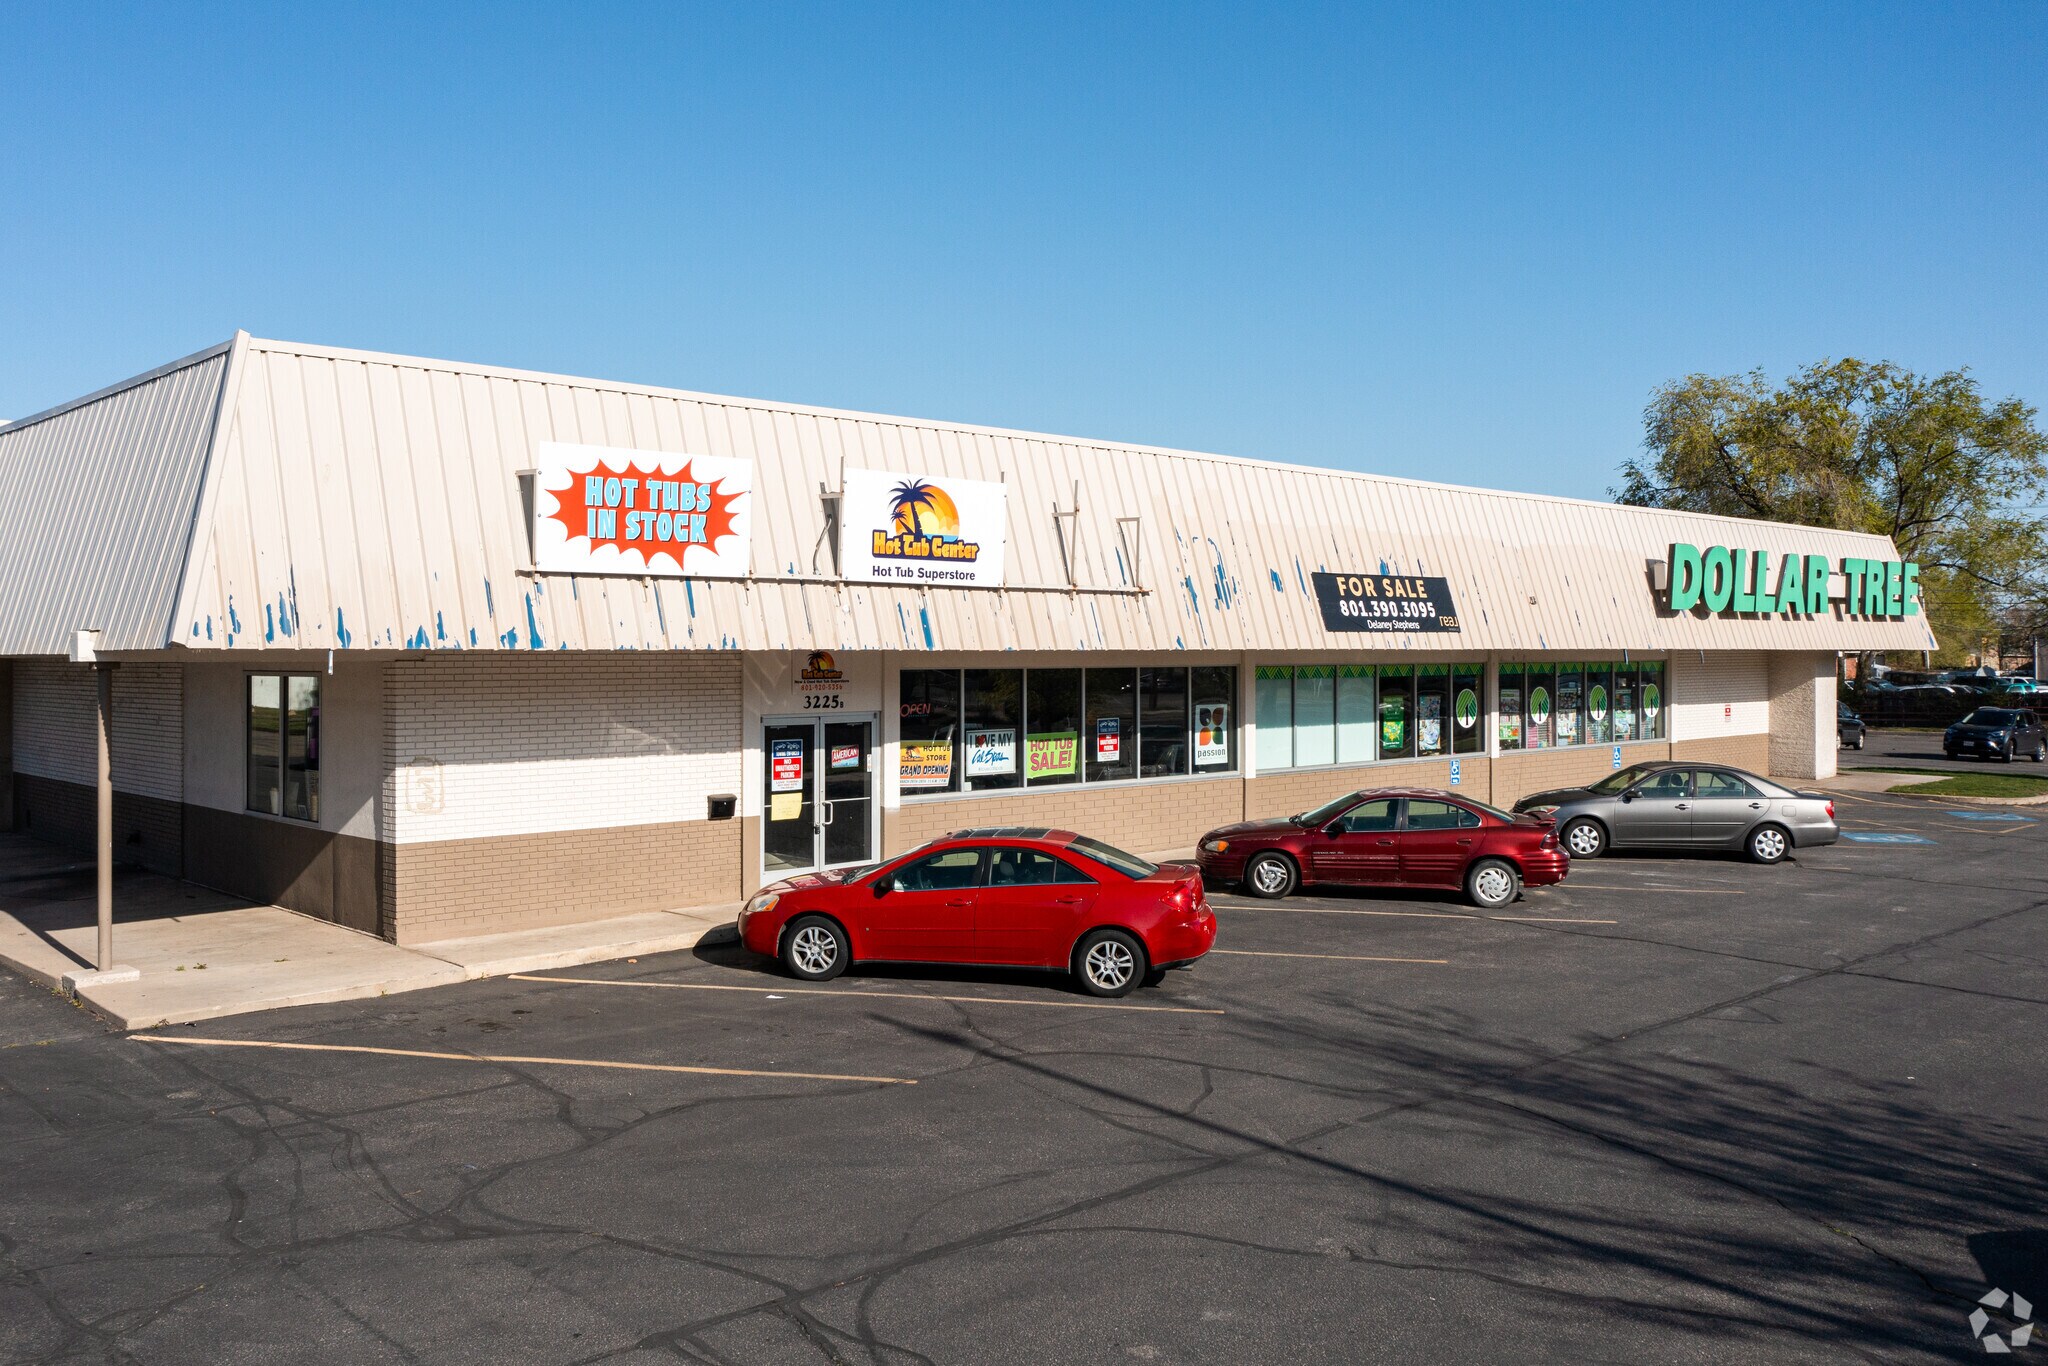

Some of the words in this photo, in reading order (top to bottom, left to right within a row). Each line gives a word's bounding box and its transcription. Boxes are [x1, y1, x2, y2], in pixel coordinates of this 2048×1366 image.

[585, 475, 640, 508] HOT
[645, 478, 712, 513] TUBS
[587, 508, 617, 540] IN
[625, 510, 708, 543] STOCK
[872, 531, 902, 556] Hot
[903, 534, 931, 557] Tub
[931, 536, 979, 560] Center
[872, 565, 892, 577] Hot
[895, 566, 914, 578] Tub
[917, 567, 976, 581] Superstore
[1668, 542, 1830, 614] DOLLAR
[1842, 557, 1919, 616] TREE
[1336, 576, 1378, 597] FOR
[1382, 578, 1428, 599] SALE
[1340, 599, 1436, 618] 801.390.3095
[1367, 619, 1393, 631] Delaney
[1393, 620, 1420, 631] Stephens
[1439, 615, 1459, 627] real
[900, 703, 931, 717] OPEN
[938, 744, 951, 752] TUB
[970, 734, 973, 749] I
[998, 732, 1013, 747] MY
[1030, 738, 1051, 752] HOT
[1054, 736, 1073, 750] TUB
[832, 747, 857, 760] AMERICAN
[971, 749, 986, 764] Cal
[1030, 750, 1073, 771] SALE!
[1197, 749, 1226, 758] passion
[900, 764, 921, 776] GRAND
[922, 763, 949, 775] OPENING
